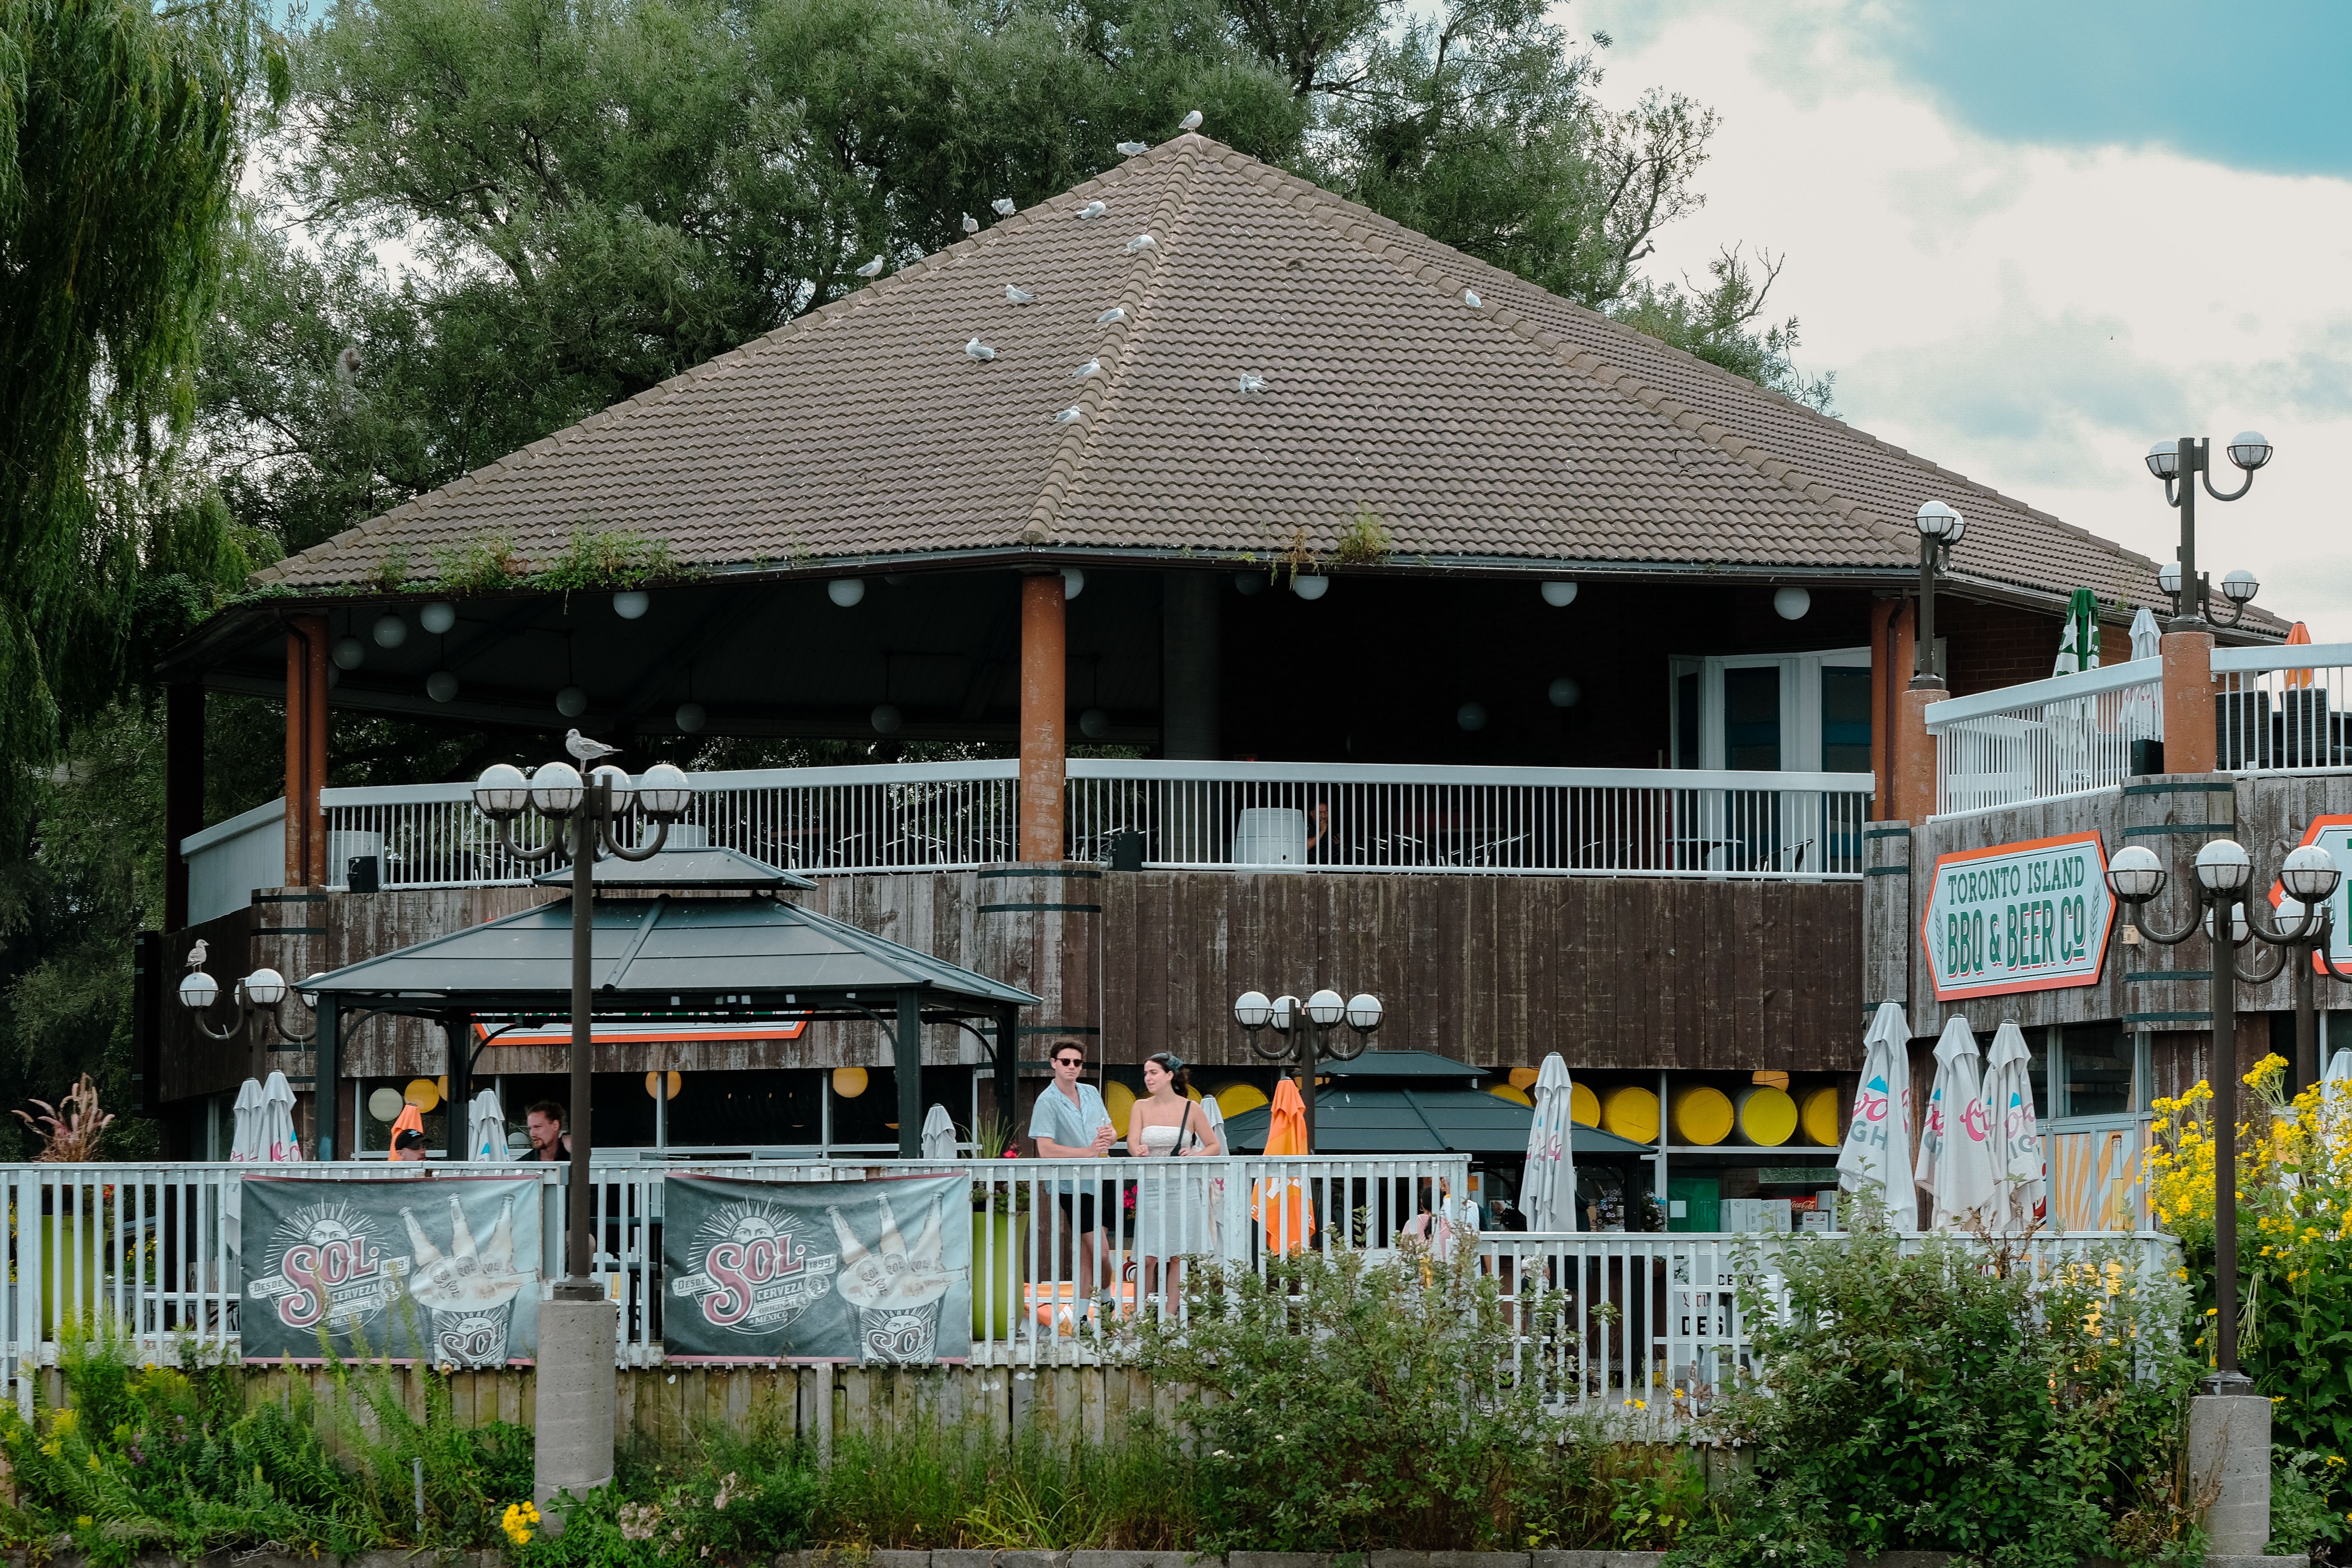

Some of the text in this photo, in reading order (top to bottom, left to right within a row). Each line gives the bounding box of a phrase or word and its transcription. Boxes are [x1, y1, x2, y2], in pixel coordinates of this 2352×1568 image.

[1948, 855, 2084, 905] TORONTO ISLAND
[1948, 909, 1984, 978] BBQ
[1990, 913, 2002, 966] &
[2007, 899, 2056, 971] BEER
[809, 1258, 831, 1269] 1899
[254, 1280, 283, 1292] DESDE
[278, 1236, 379, 1328] SOL
[678, 1277, 707, 1289] DESDE
[702, 1233, 806, 1326] SOL
[332, 1283, 377, 1302] CERVEZA
[757, 1282, 803, 1301] CERVEZA
[760, 1300, 795, 1314] ORIGINAL
